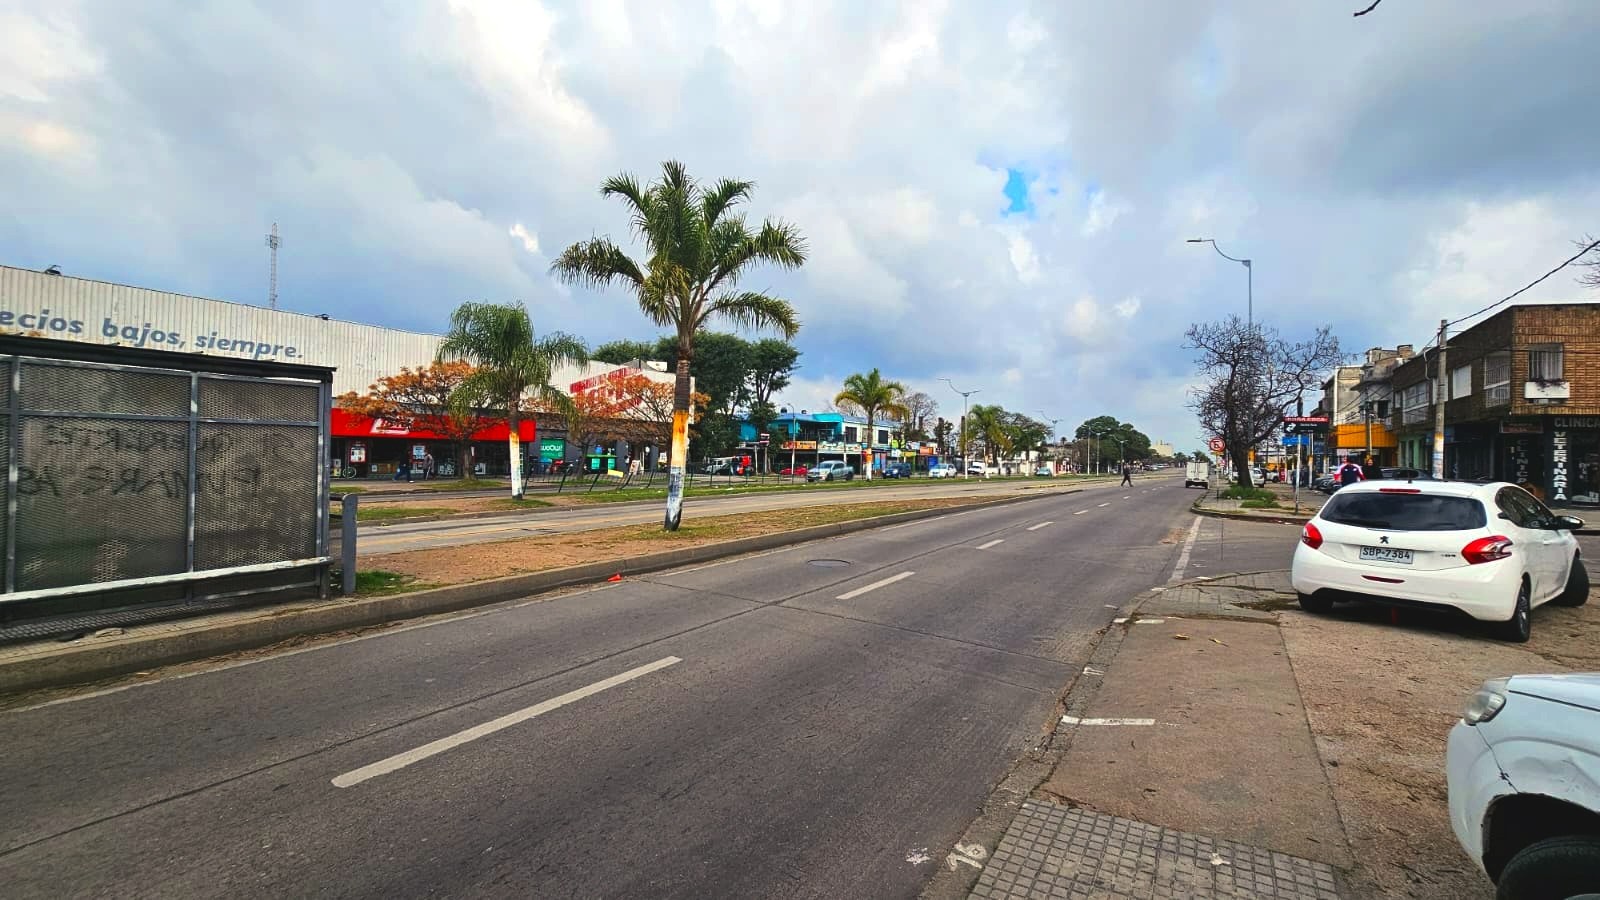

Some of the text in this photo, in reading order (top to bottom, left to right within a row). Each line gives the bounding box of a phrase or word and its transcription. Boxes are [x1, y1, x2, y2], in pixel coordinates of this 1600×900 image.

[102, 318, 185, 348] bajos,
[196, 331, 304, 360] siempre.
[1553, 432, 1568, 500] VETERINARIA
